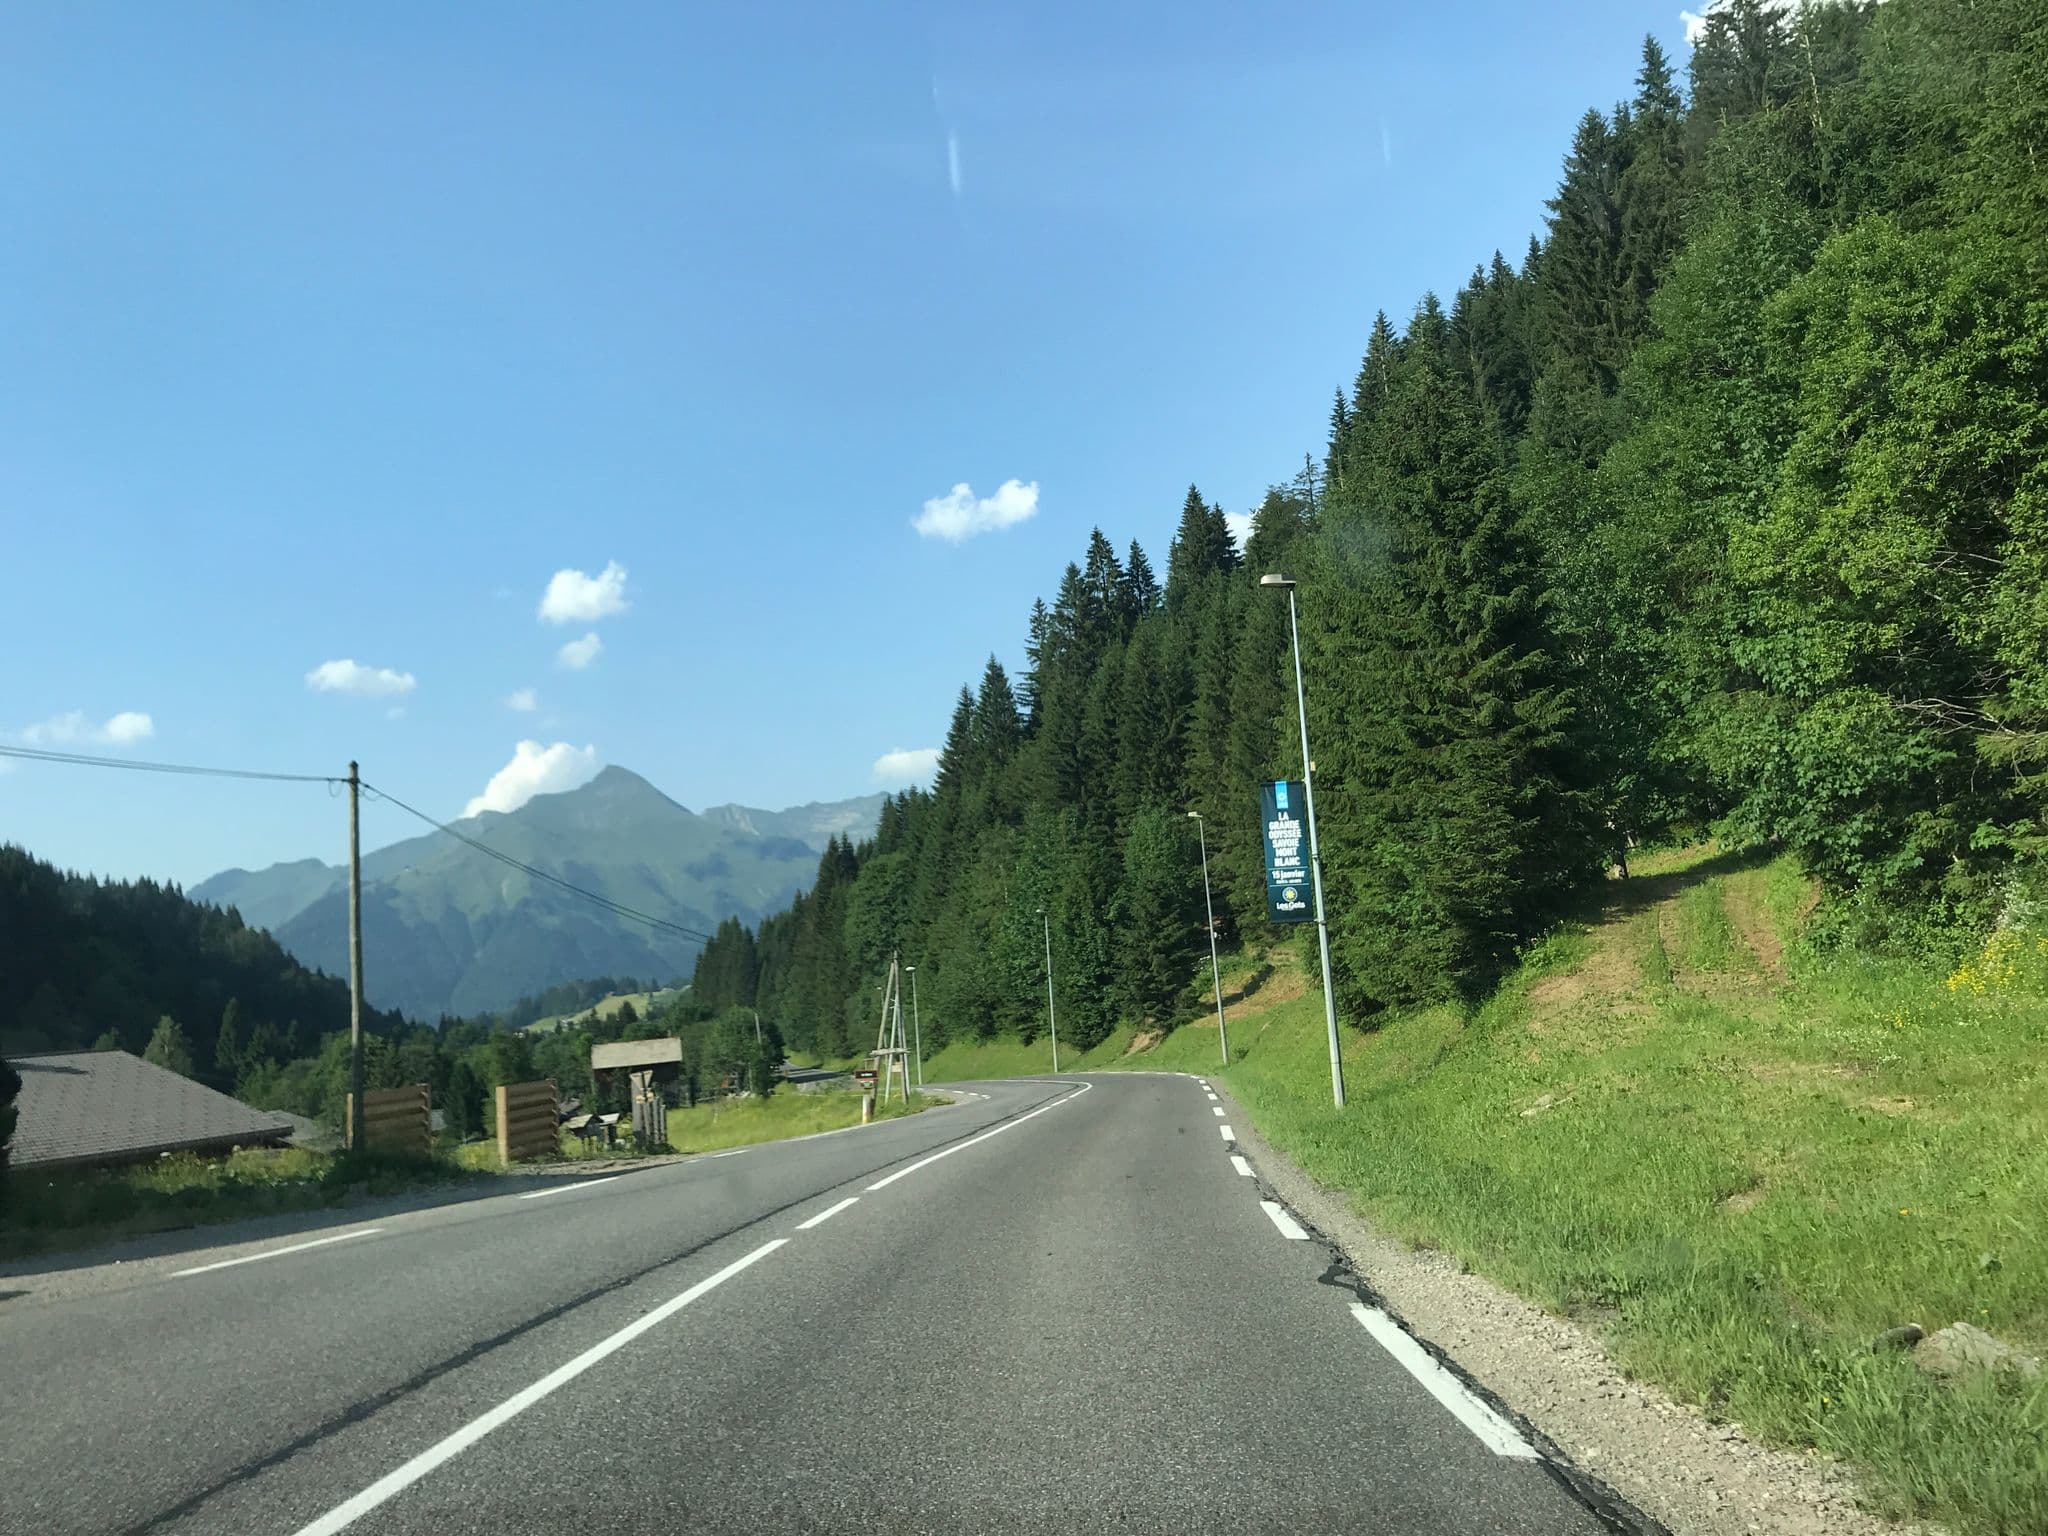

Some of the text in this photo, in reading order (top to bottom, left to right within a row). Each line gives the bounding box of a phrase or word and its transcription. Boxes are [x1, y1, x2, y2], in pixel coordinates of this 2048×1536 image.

[1278, 811, 1289, 820] LA
[1268, 820, 1300, 830] GRANDE
[1272, 838, 1300, 848] SAVOIE
[1275, 847, 1298, 857] MONT
[1274, 856, 1301, 867] BLANC
